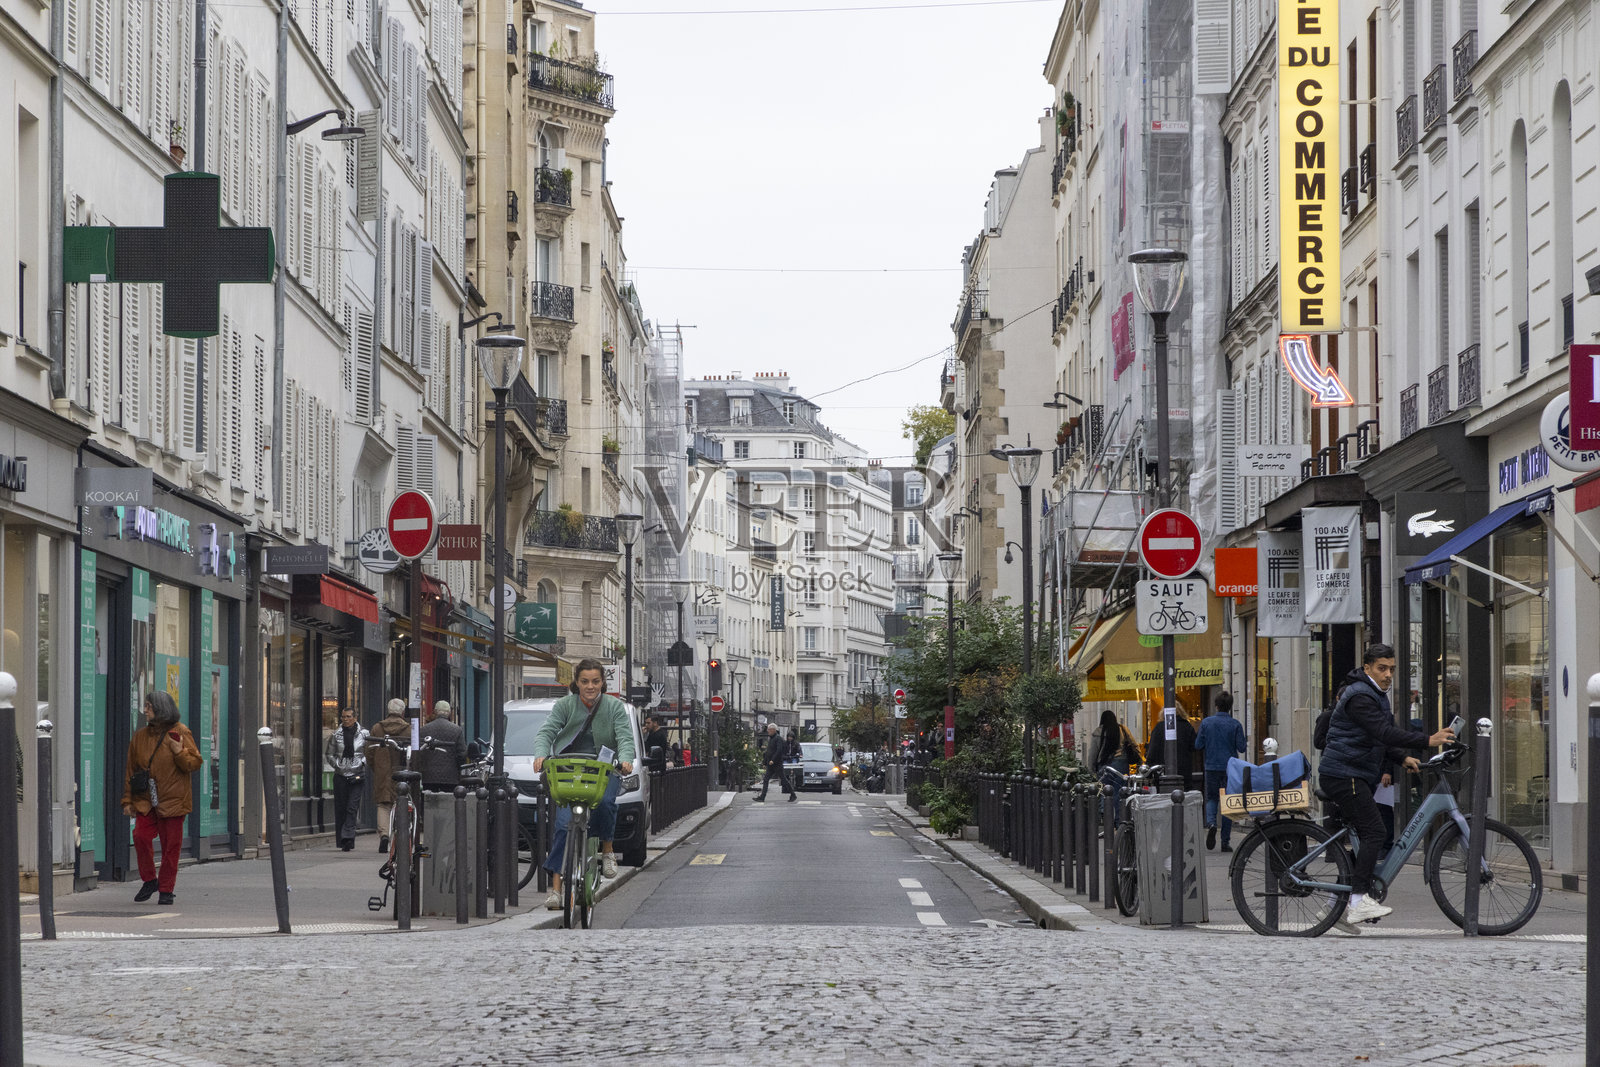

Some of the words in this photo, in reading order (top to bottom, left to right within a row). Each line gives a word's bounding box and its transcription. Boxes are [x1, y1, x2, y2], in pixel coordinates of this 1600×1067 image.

[1297, 0, 1321, 35] E
[1288, 46, 1331, 67] DU
[1295, 79, 1326, 326] COMMERCE
[1549, 435, 1577, 461] PETIT
[1252, 461, 1286, 470] Femme
[85, 489, 140, 503] KOOKAÏ
[1314, 526, 1329, 535] 100
[1331, 525, 1349, 534] ANS
[438, 536, 478, 549] RTHUR
[271, 553, 324, 563] ANTONELLE
[1283, 548, 1300, 556] ANS
[1316, 573, 1324, 581] LE
[1342, 572, 1350, 580] DU
[1150, 583, 1195, 597] SAUF
[1218, 583, 1259, 595] orange
[1316, 580, 1350, 588] COMMERCE
[1116, 674, 1131, 682] Mon
[1133, 669, 1164, 681] Panie
[1229, 798, 1242, 807] LA
[1402, 811, 1425, 839] Dance
